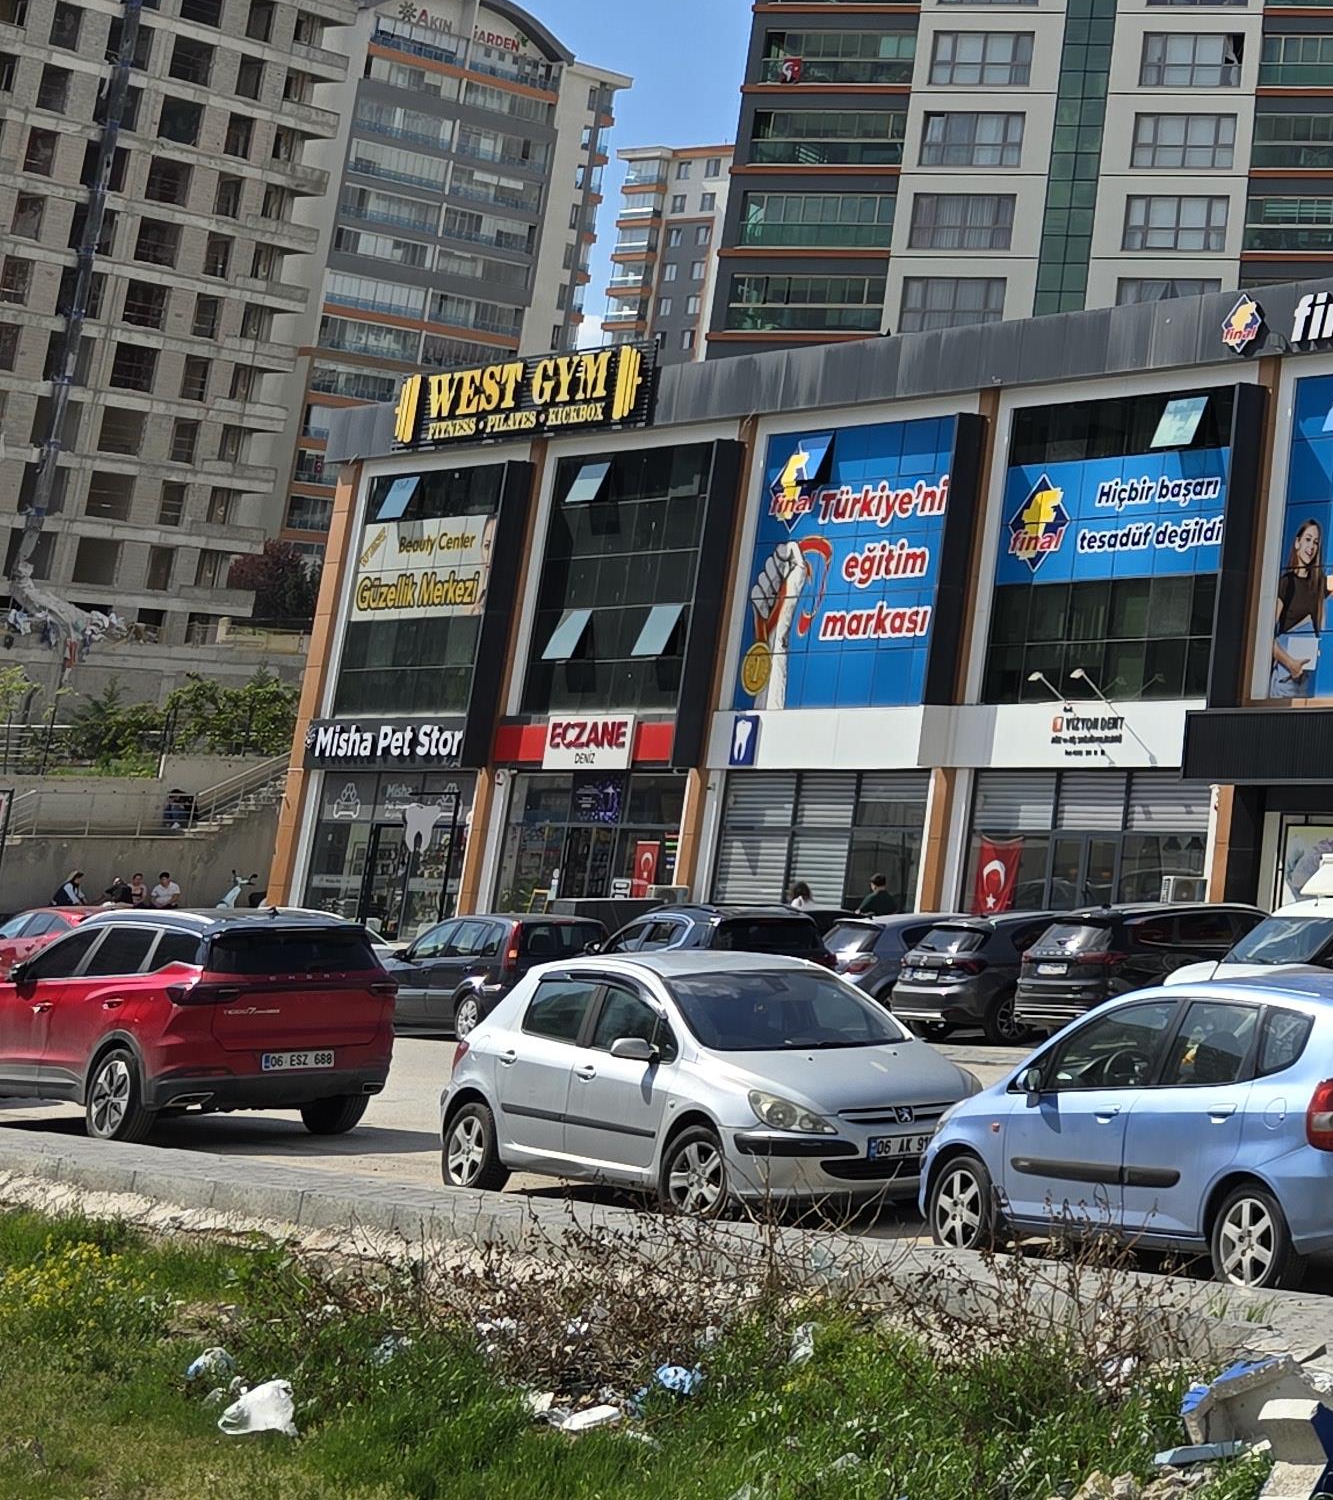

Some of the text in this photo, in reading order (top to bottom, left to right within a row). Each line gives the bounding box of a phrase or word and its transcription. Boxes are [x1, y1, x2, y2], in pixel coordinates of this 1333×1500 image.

[1222, 324, 1257, 343] final
[428, 350, 613, 419] WEST GYM
[546, 401, 606, 427] KICKBOX
[1096, 476, 1222, 511] Hiçbir başarı
[398, 531, 476, 556] Beauty Center
[1009, 527, 1065, 554] final
[1078, 521, 1153, 553] tesadüf
[844, 540, 928, 587] eğitim
[356, 570, 481, 612] Güzellik Merkezi
[819, 601, 931, 641] markası
[314, 726, 373, 759] Misha
[376, 726, 414, 757] Pet
[549, 720, 629, 751] ECZANE
[270, 1055, 284, 1067] 06
[289, 1053, 309, 1067] ESZ
[876, 1139, 892, 1155] 06
[898, 1137, 912, 1153] AK
